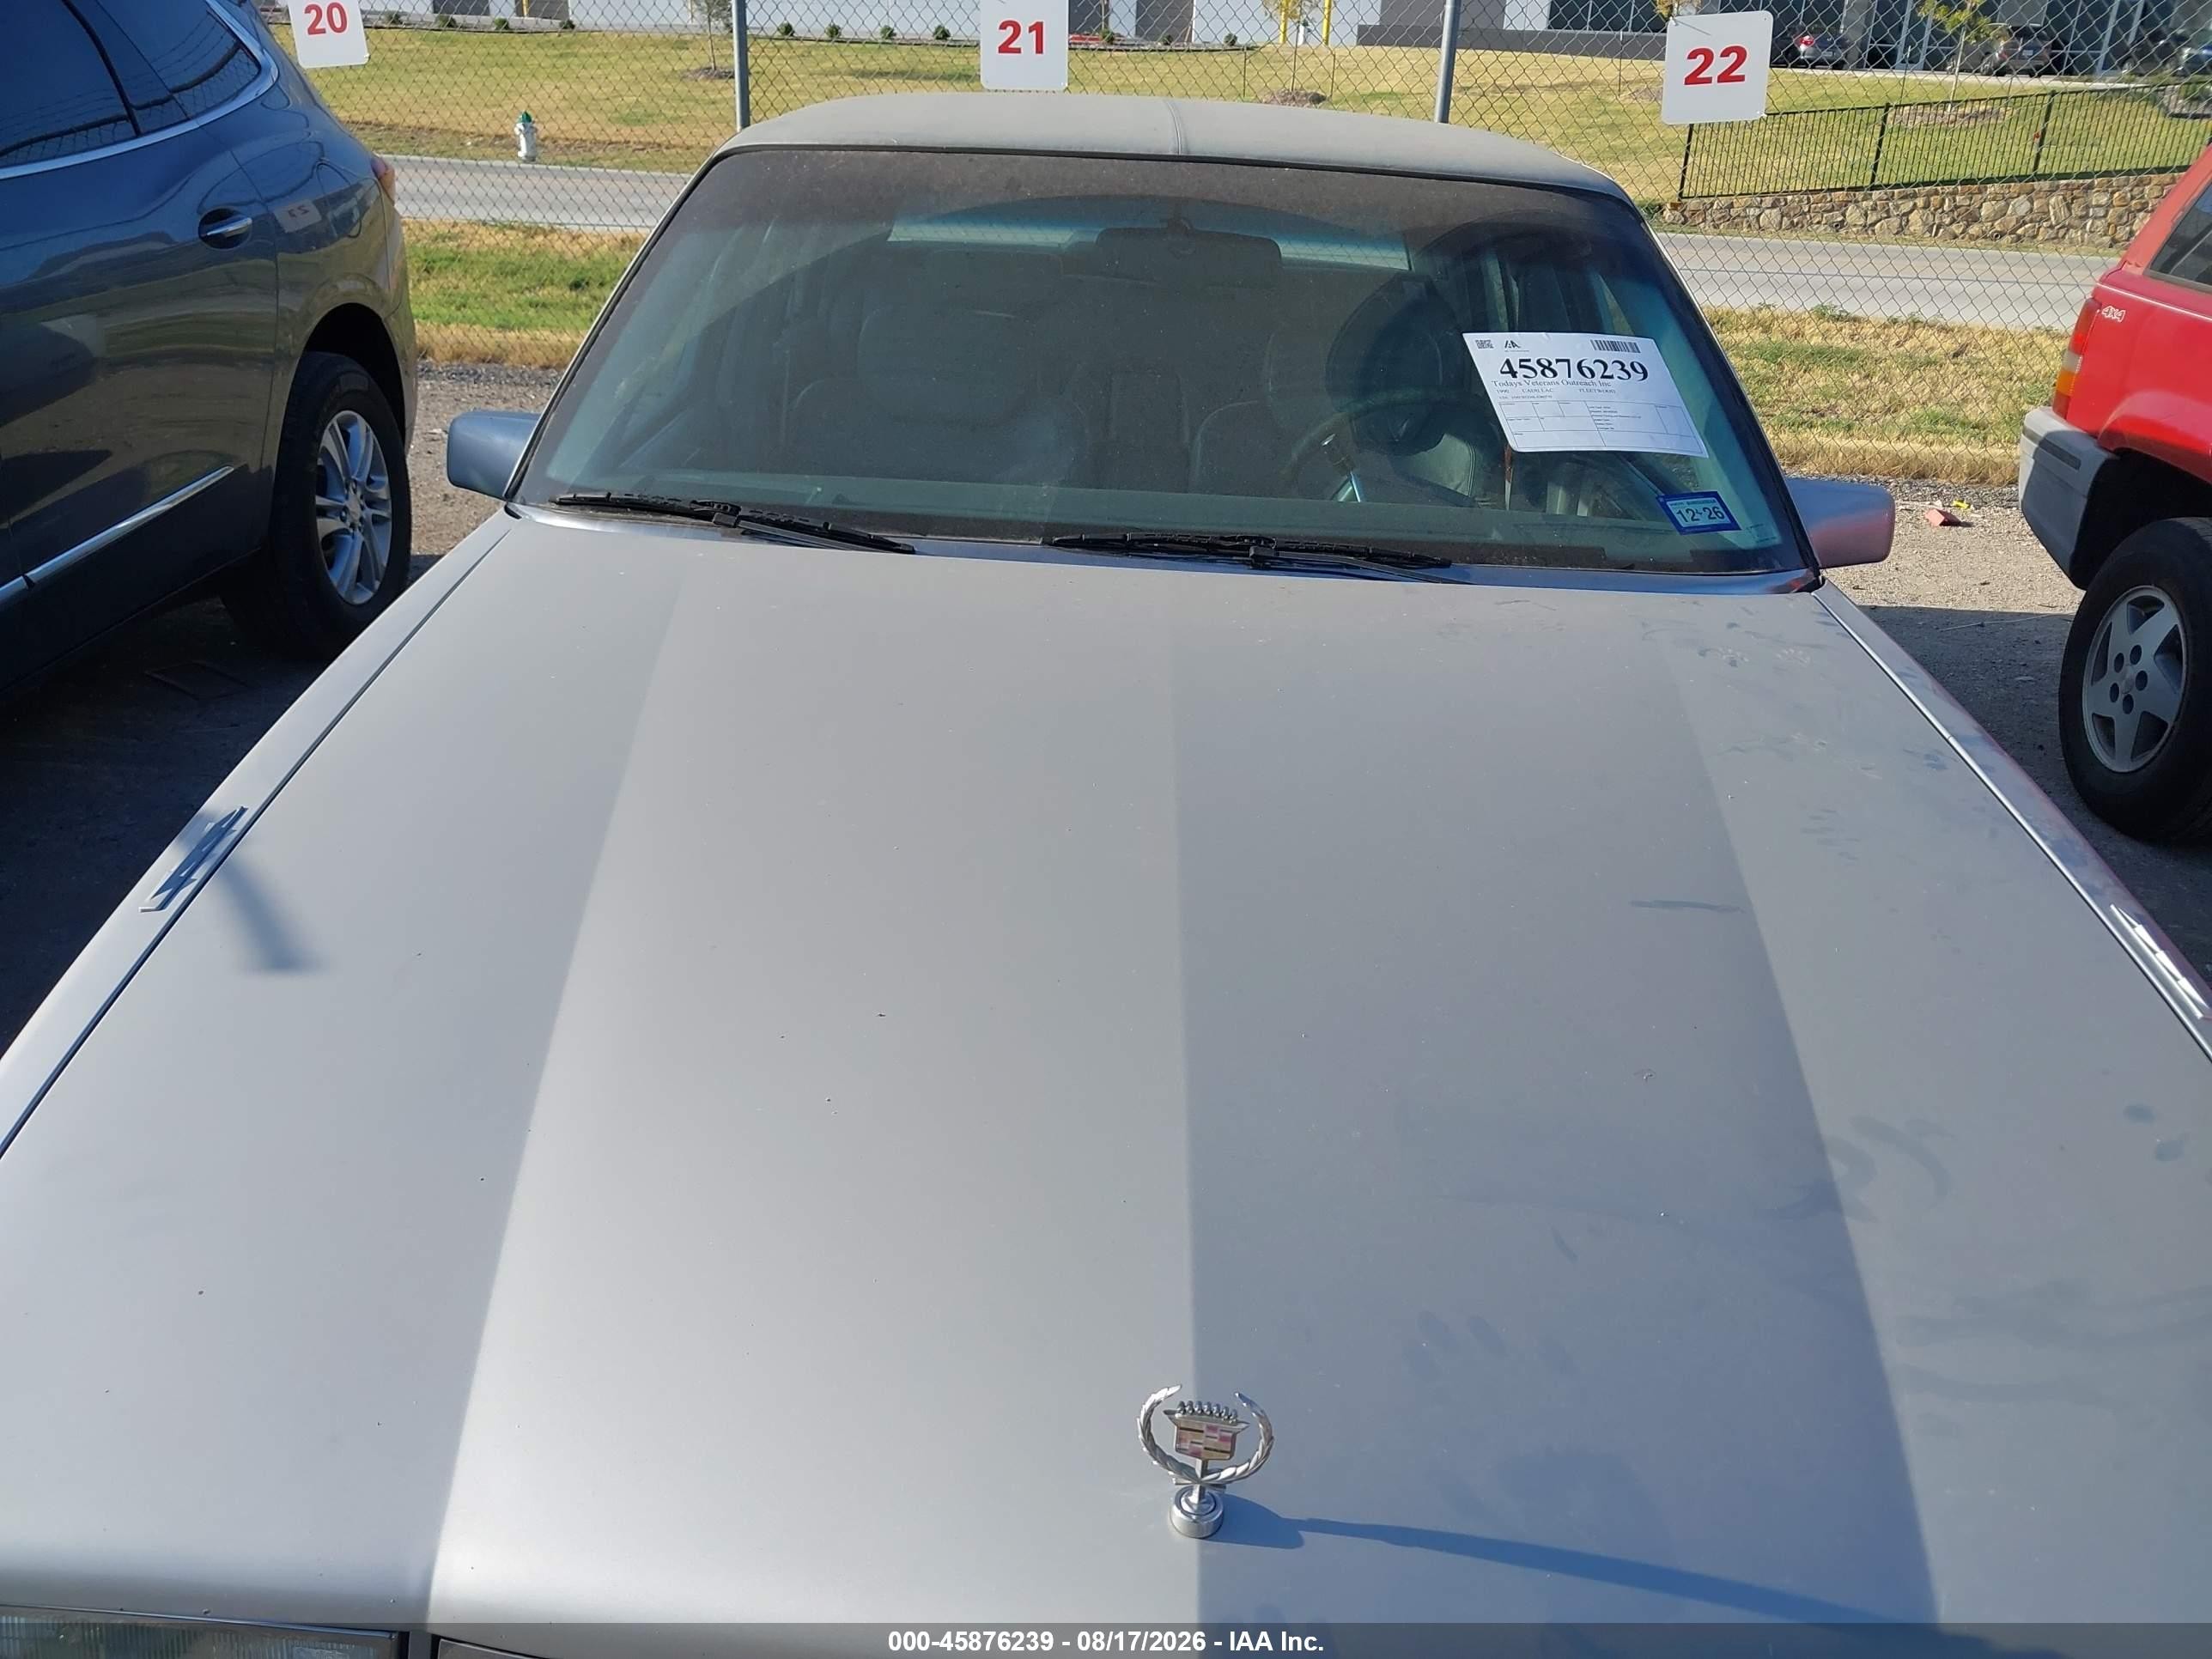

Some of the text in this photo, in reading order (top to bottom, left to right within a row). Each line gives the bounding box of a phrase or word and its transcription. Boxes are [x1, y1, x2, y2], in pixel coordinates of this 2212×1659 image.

[307, 3, 347, 35] 20
[998, 20, 1044, 55] 21
[1684, 46, 1747, 86] 22
[1499, 357, 1649, 381] 45876239
